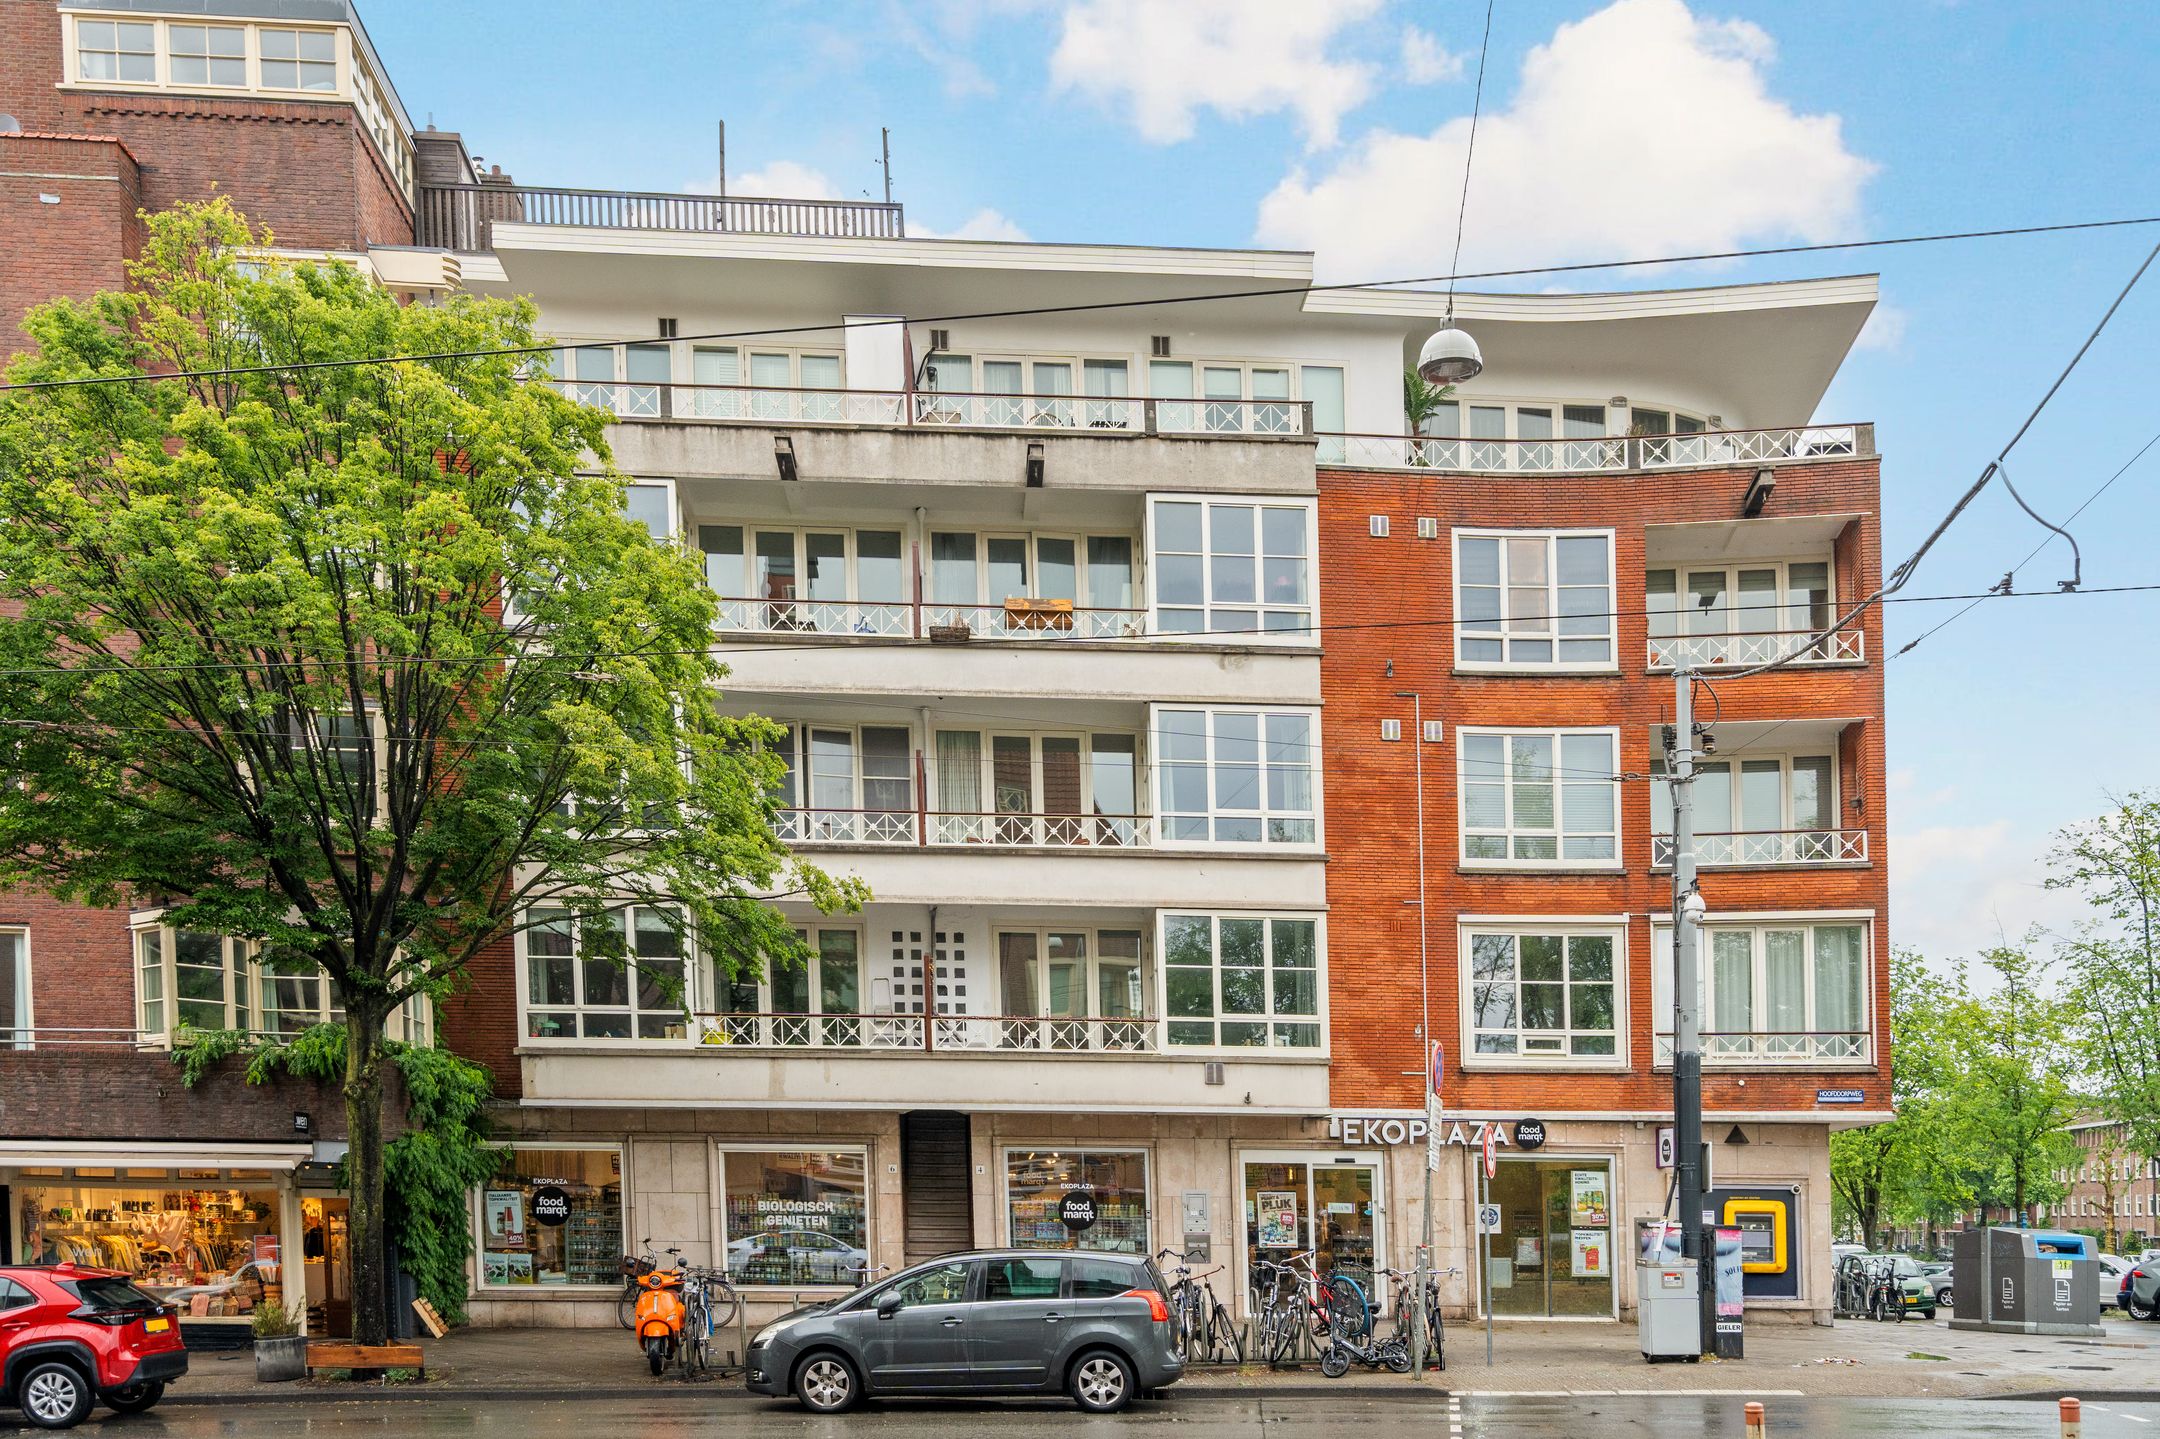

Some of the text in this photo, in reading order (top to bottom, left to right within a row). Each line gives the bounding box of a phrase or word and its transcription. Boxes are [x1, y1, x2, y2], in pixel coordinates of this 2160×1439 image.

[1520, 1125, 1540, 1134] food
[1518, 1133, 1544, 1143] marqt
[977, 1166, 983, 1174] 4
[539, 1196, 564, 1206] food
[1065, 1201, 1090, 1211] food
[1262, 1199, 1292, 1211] PLUK
[536, 1206, 568, 1217] marqt
[757, 1201, 834, 1212] BIOLOGISCH
[766, 1214, 828, 1226] GENIETEN
[1063, 1210, 1094, 1221] marqt
